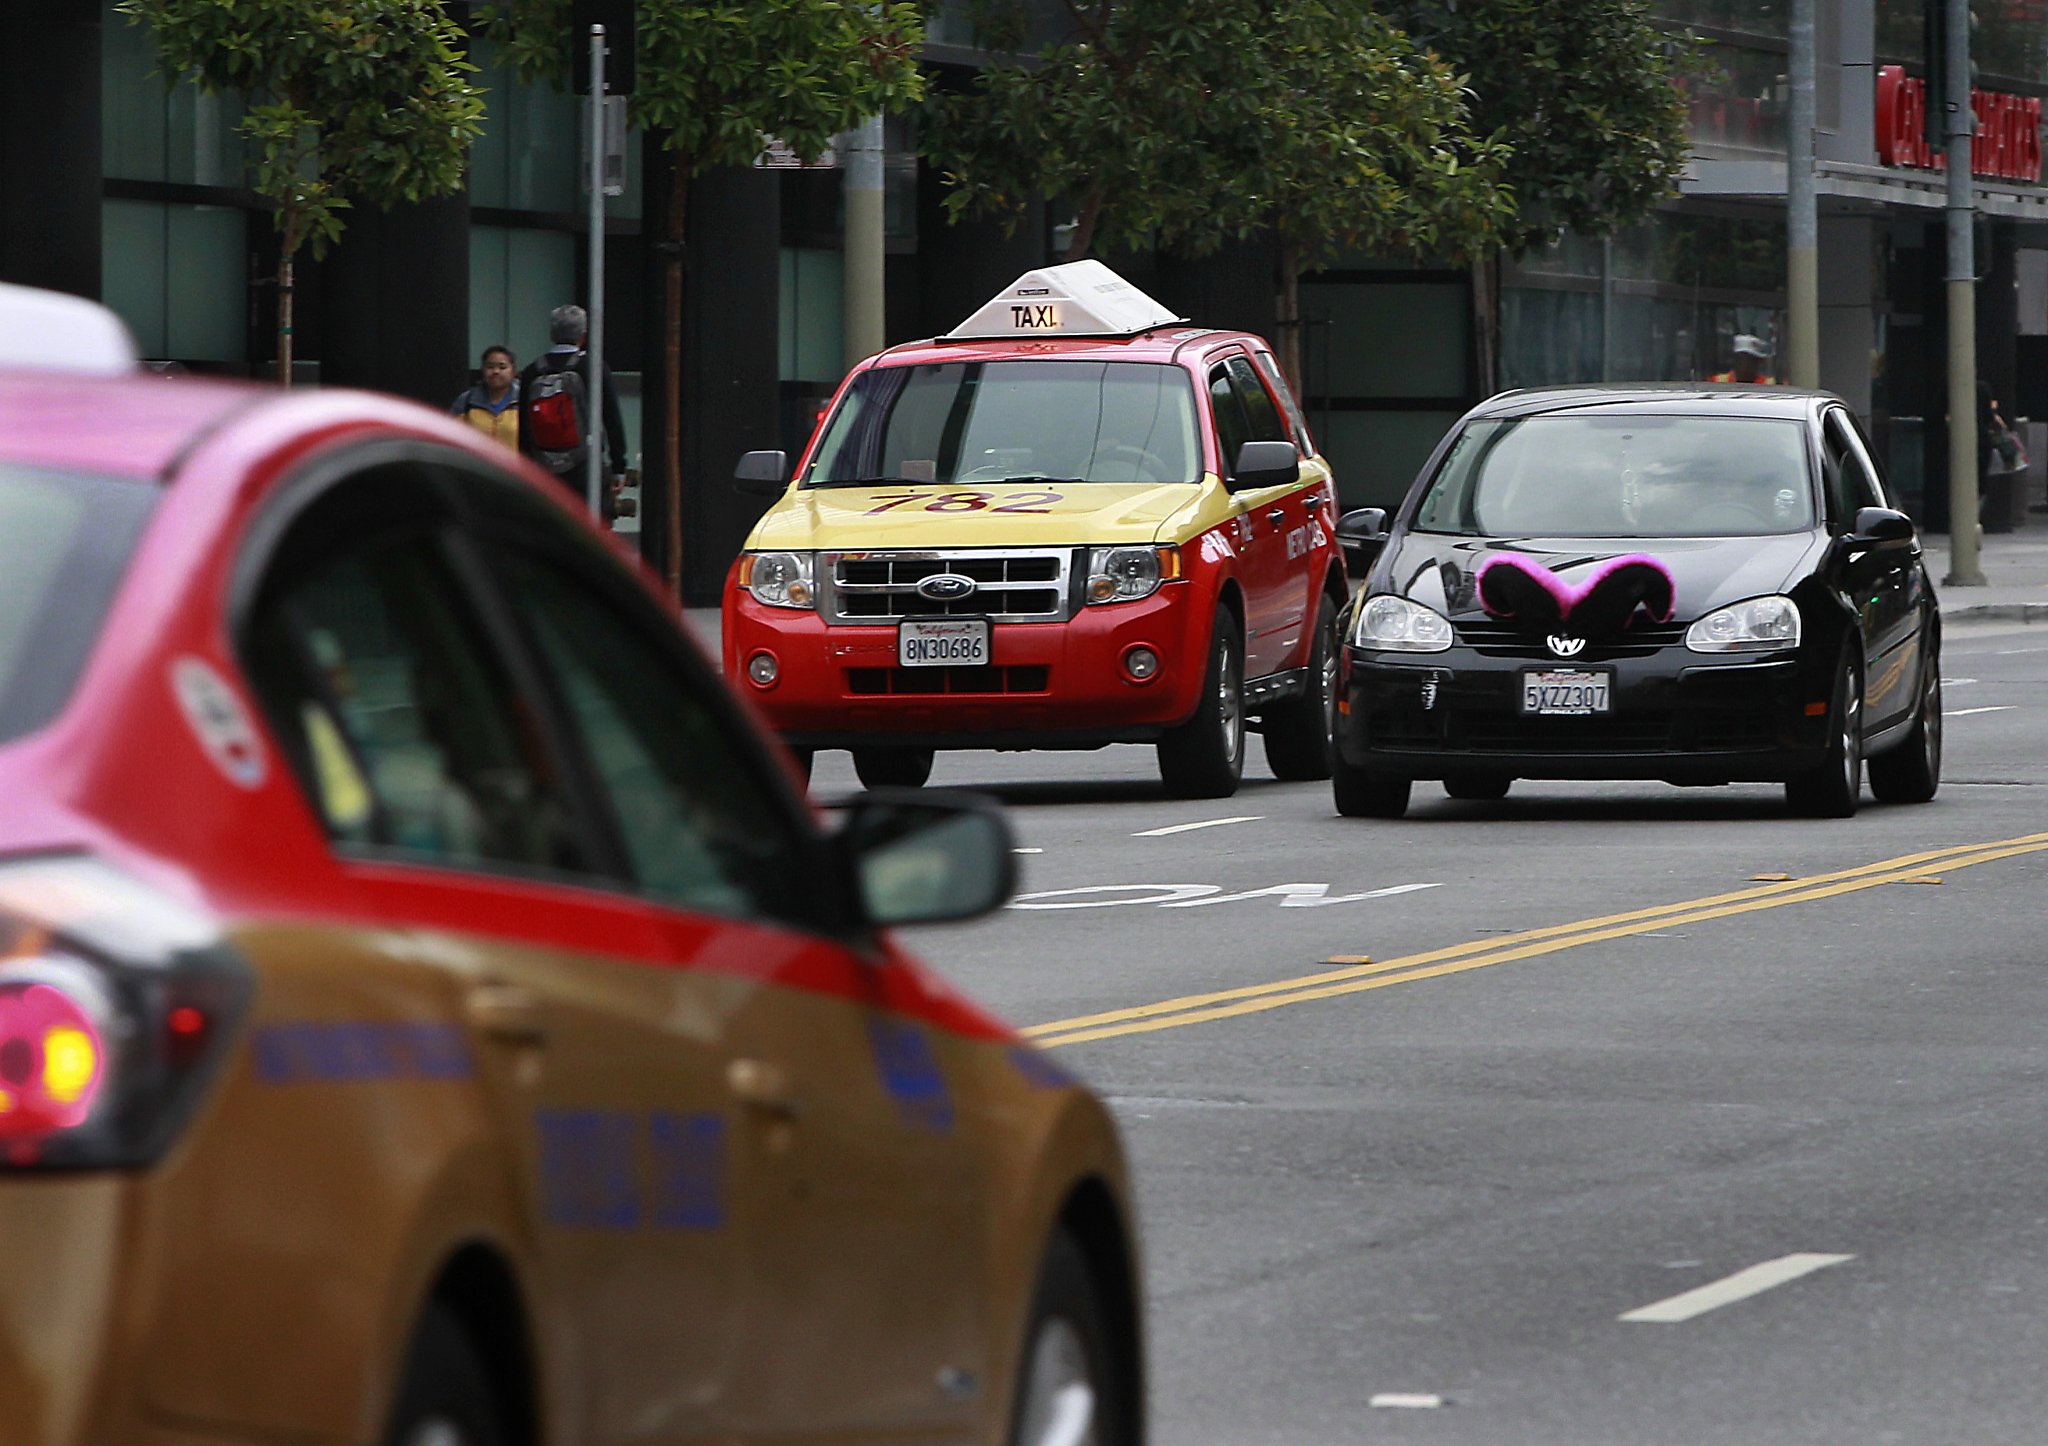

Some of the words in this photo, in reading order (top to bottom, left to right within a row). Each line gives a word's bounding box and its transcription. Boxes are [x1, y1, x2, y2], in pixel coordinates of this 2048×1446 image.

[1011, 305, 1057, 328] TAXI
[863, 492, 1064, 516] 782
[906, 637, 982, 660] 8N30686
[1526, 685, 1606, 708] 5XZZ307
